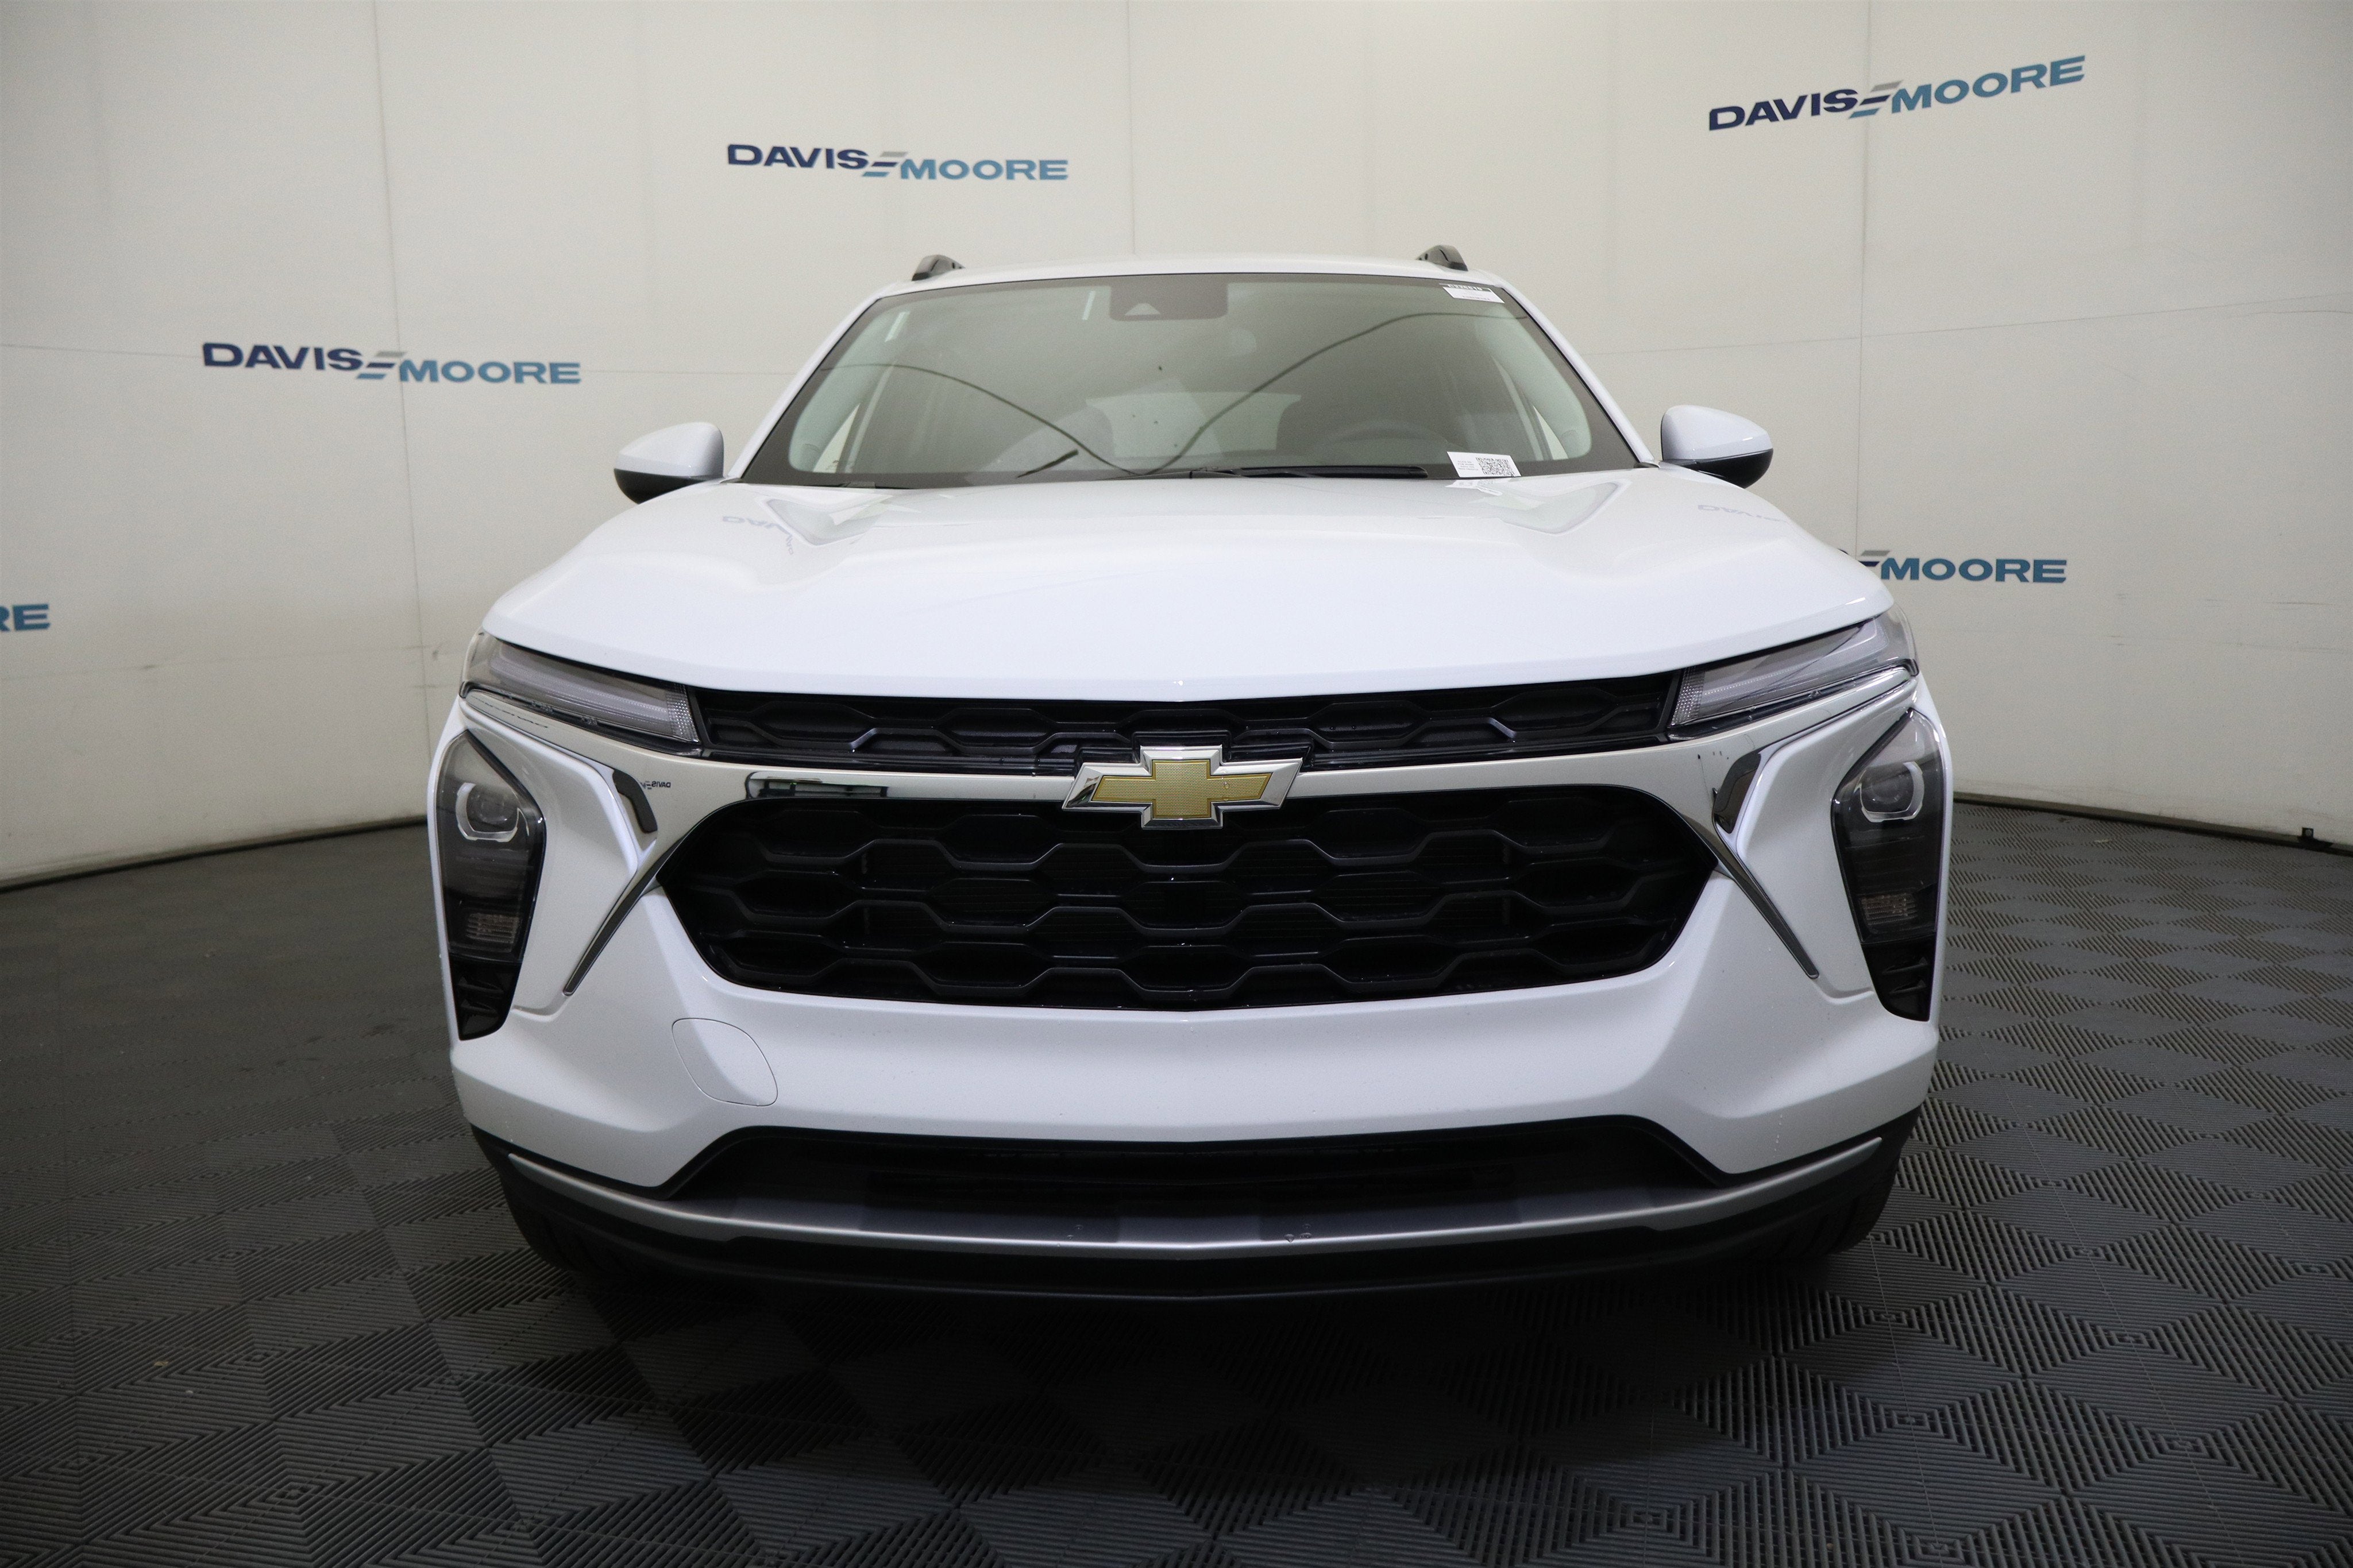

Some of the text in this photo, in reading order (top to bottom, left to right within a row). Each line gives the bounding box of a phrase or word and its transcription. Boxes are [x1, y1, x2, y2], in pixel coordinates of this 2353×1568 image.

[1708, 55, 2085, 132] DAVIS MOORE
[727, 144, 1068, 180] DAVIS MOORE
[202, 342, 581, 384] DAVIS MOORE
[1880, 557, 2067, 584] MOORE
